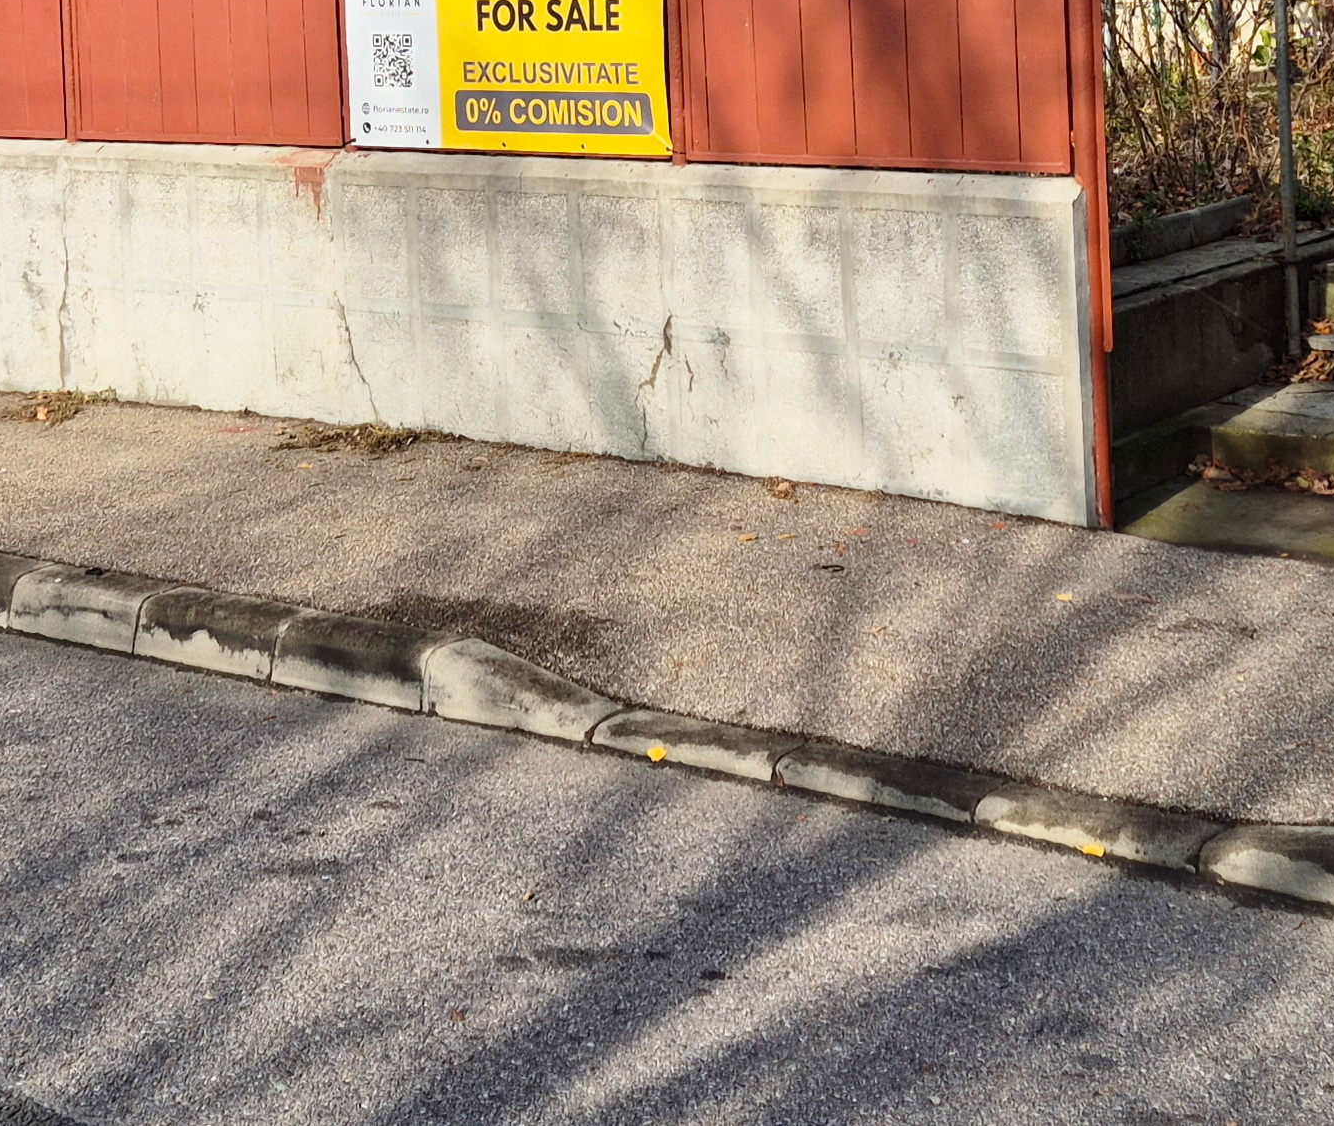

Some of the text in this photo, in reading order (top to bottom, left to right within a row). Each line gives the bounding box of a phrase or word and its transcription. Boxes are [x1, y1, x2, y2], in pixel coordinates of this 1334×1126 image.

[476, 0, 539, 32] FOR
[463, 61, 640, 85] EXCLUSIVITATE
[373, 105, 430, 115] florianestate.ro
[464, 96, 644, 128] 0% COMISION
